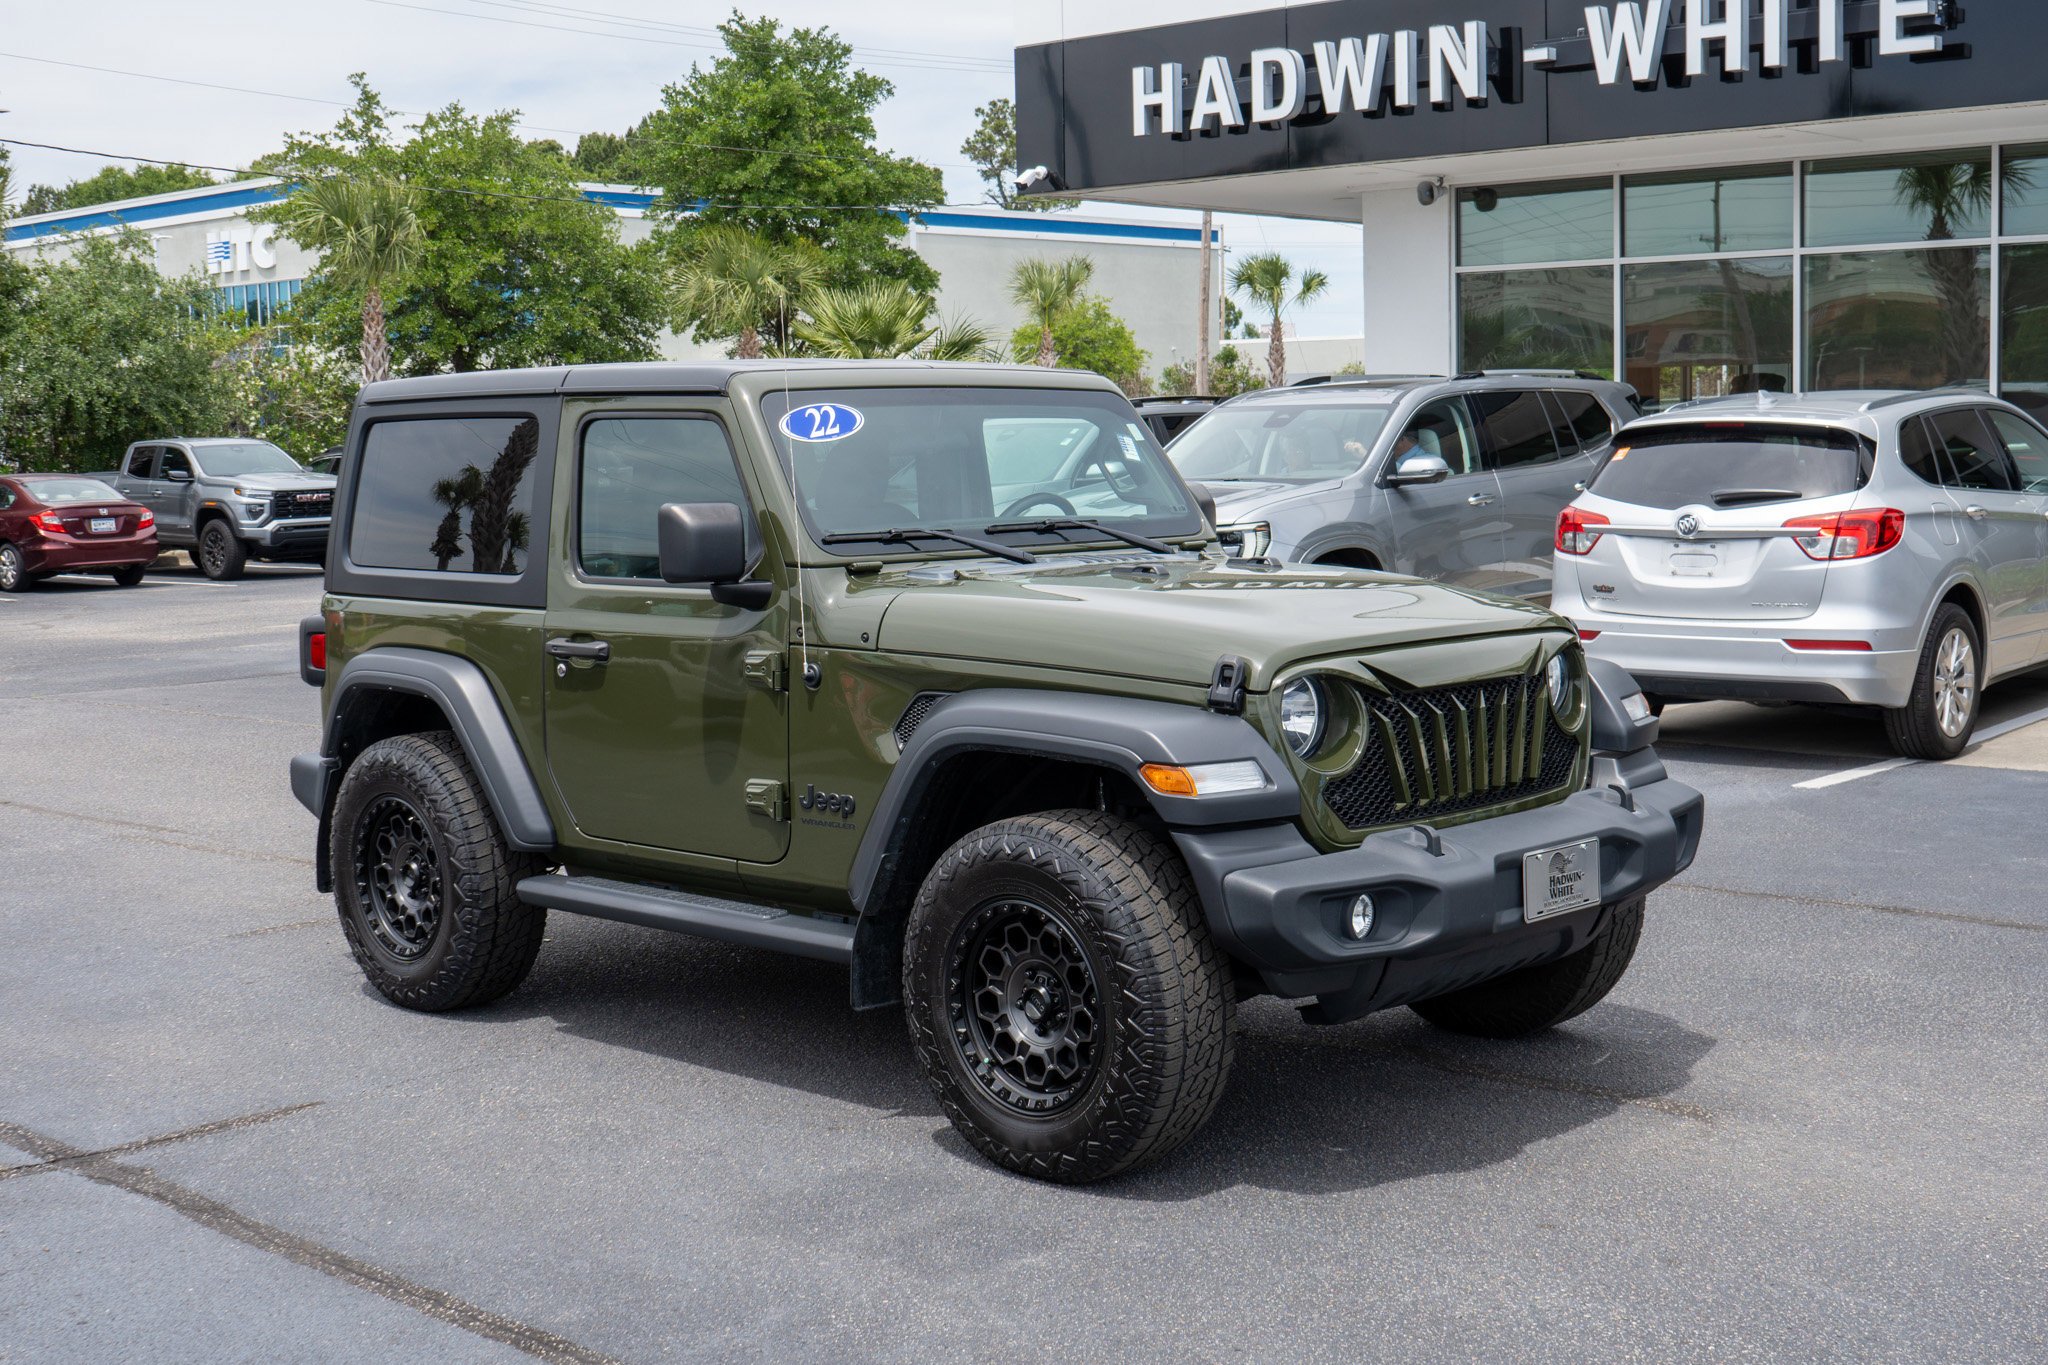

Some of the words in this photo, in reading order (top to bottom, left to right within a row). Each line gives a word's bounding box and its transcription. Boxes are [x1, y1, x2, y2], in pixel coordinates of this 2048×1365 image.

[1131, 20, 1487, 136] HADWIN
[206, 222, 277, 275] HTC
[805, 405, 840, 438] 22
[799, 783, 856, 819] Jeep
[801, 817, 856, 831] WRANGLER
[1548, 884, 1575, 900] WHITE
